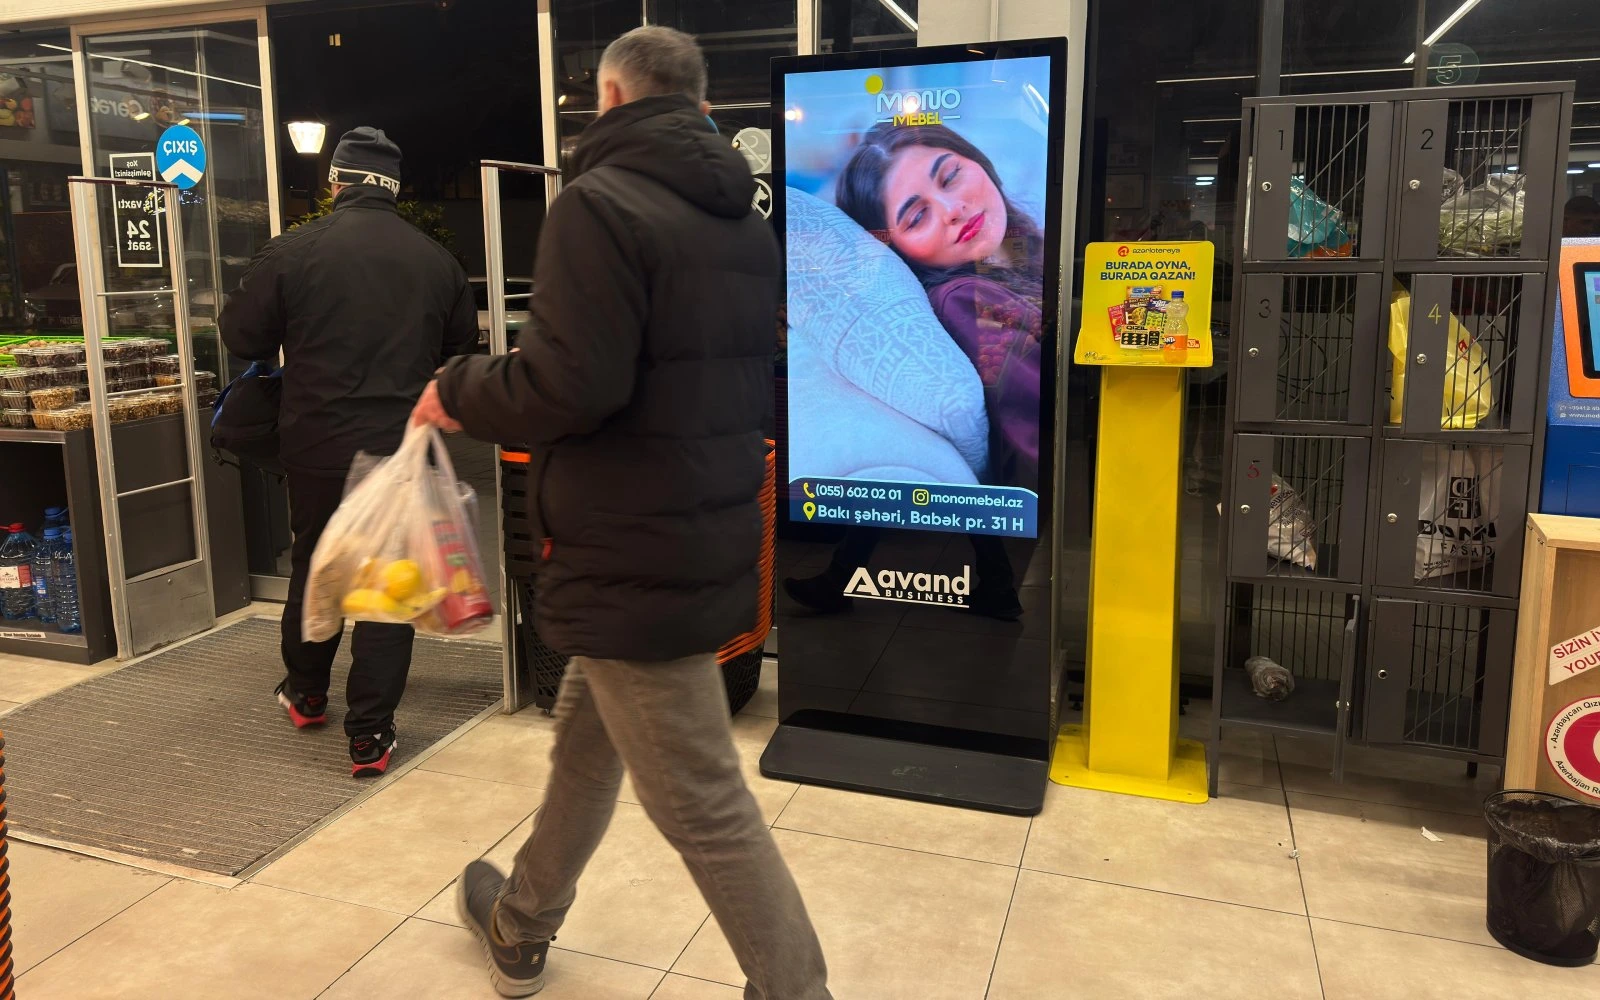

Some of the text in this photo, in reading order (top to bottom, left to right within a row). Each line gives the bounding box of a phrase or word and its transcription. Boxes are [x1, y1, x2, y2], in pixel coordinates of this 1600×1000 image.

[876, 88, 961, 113] MONO
[893, 111, 943, 127] MEBEL
[163, 141, 198, 156] ÇIXIŞ
[1277, 129, 1285, 150] 1
[1420, 129, 1434, 150] 2
[1100, 271, 1196, 281] BURADA QAZAN!
[1105, 261, 1191, 271] BURADA OYNA,
[1428, 303, 1442, 325] 4
[815, 483, 902, 501] (055) 602 02 01
[930, 492, 1023, 509] monomebel.az
[818, 503, 1024, 531] Bakı şəhəri, Babək pr. 31 H
[885, 589, 964, 604] BUSINESS
[1553, 636, 1592, 659] SİZİN
[1550, 706, 1583, 743] Azərbaycan
[1555, 760, 1590, 790] Azerbaijan
